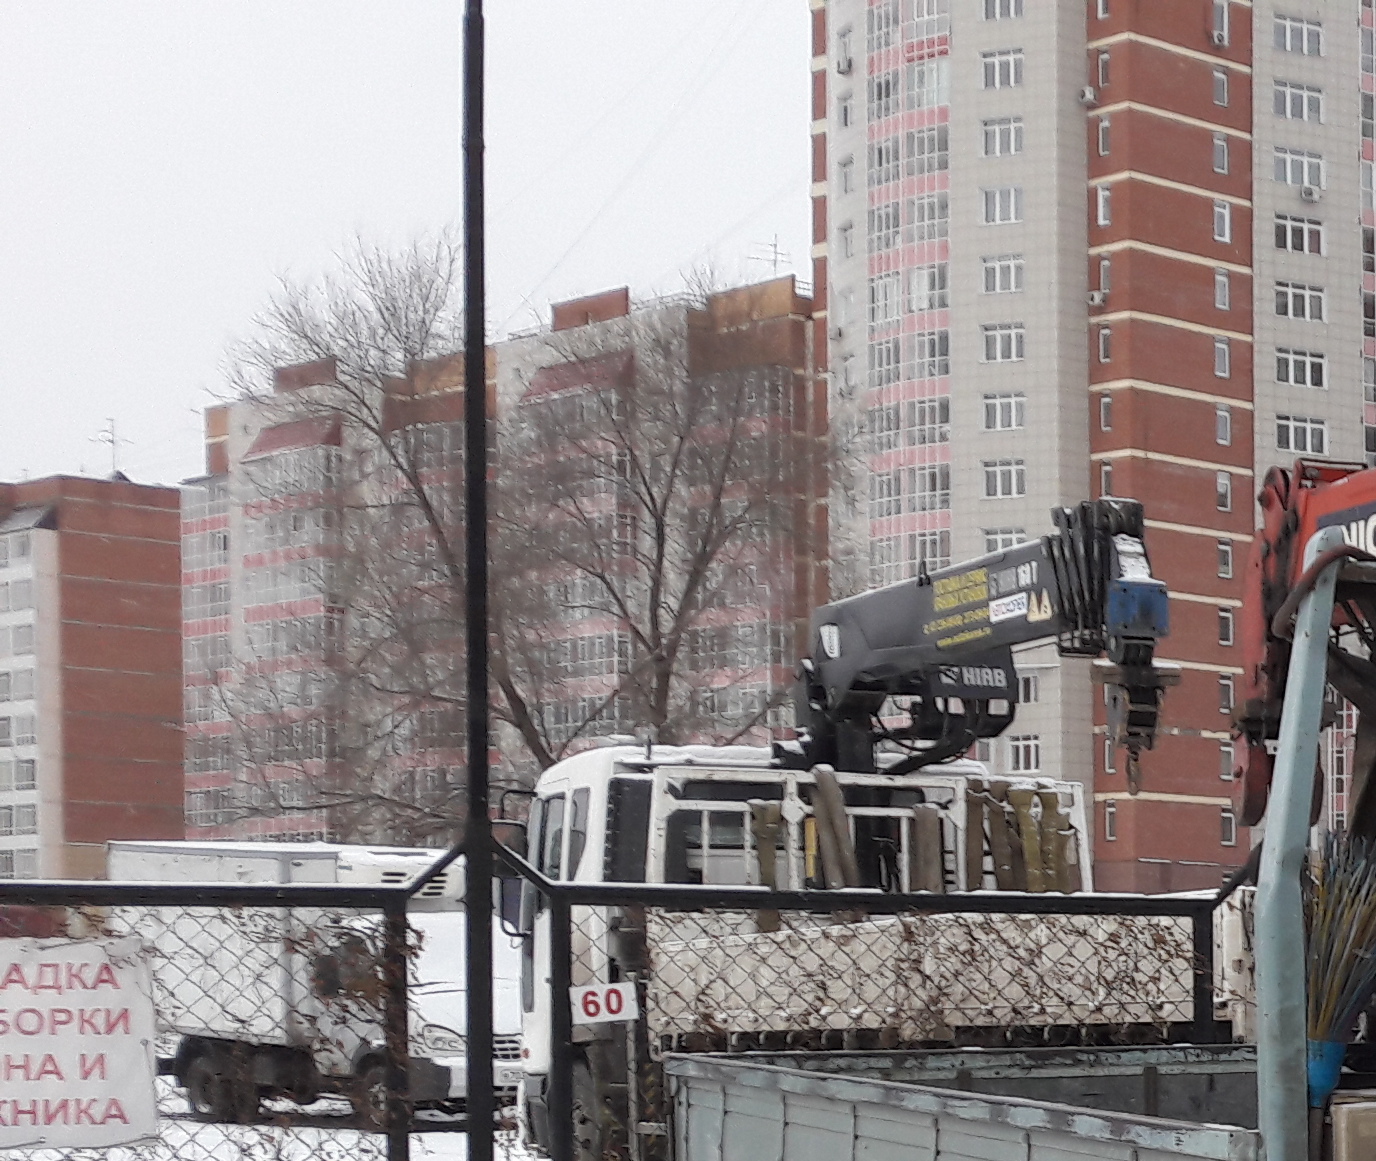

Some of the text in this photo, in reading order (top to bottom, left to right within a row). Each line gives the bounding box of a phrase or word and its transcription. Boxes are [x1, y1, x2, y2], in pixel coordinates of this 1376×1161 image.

[961, 666, 1007, 688] HIAB
[581, 988, 623, 1018] 60
[80, 1053, 105, 1081] И
